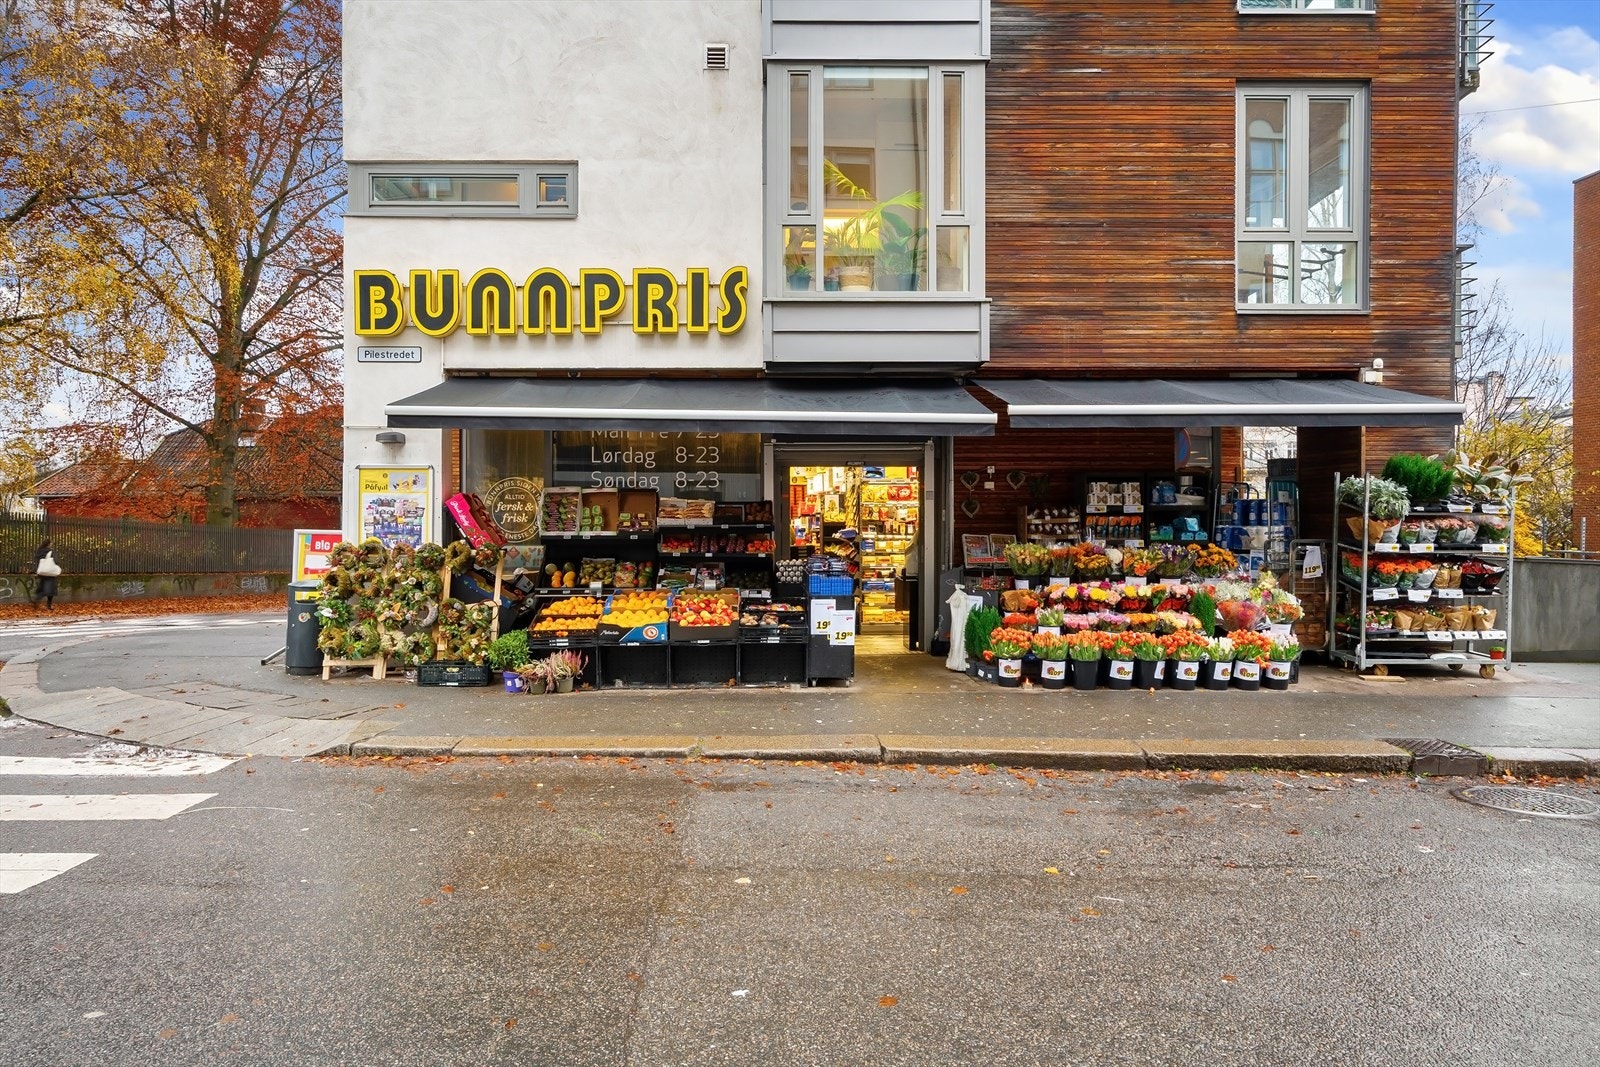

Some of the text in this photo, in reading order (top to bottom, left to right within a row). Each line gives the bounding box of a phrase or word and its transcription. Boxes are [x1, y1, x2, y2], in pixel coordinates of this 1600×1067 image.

[354, 266, 748, 337] BUNNPRIS
[364, 350, 415, 359] Pilestredet
[591, 446, 720, 469] Lørdag 8-23
[486, 480, 515, 506] BUNNPRIS
[516, 480, 537, 494] SIDEN
[590, 471, 720, 493] Søndag 8-23
[495, 501, 534, 513] fersk &
[501, 513, 529, 525] frisk
